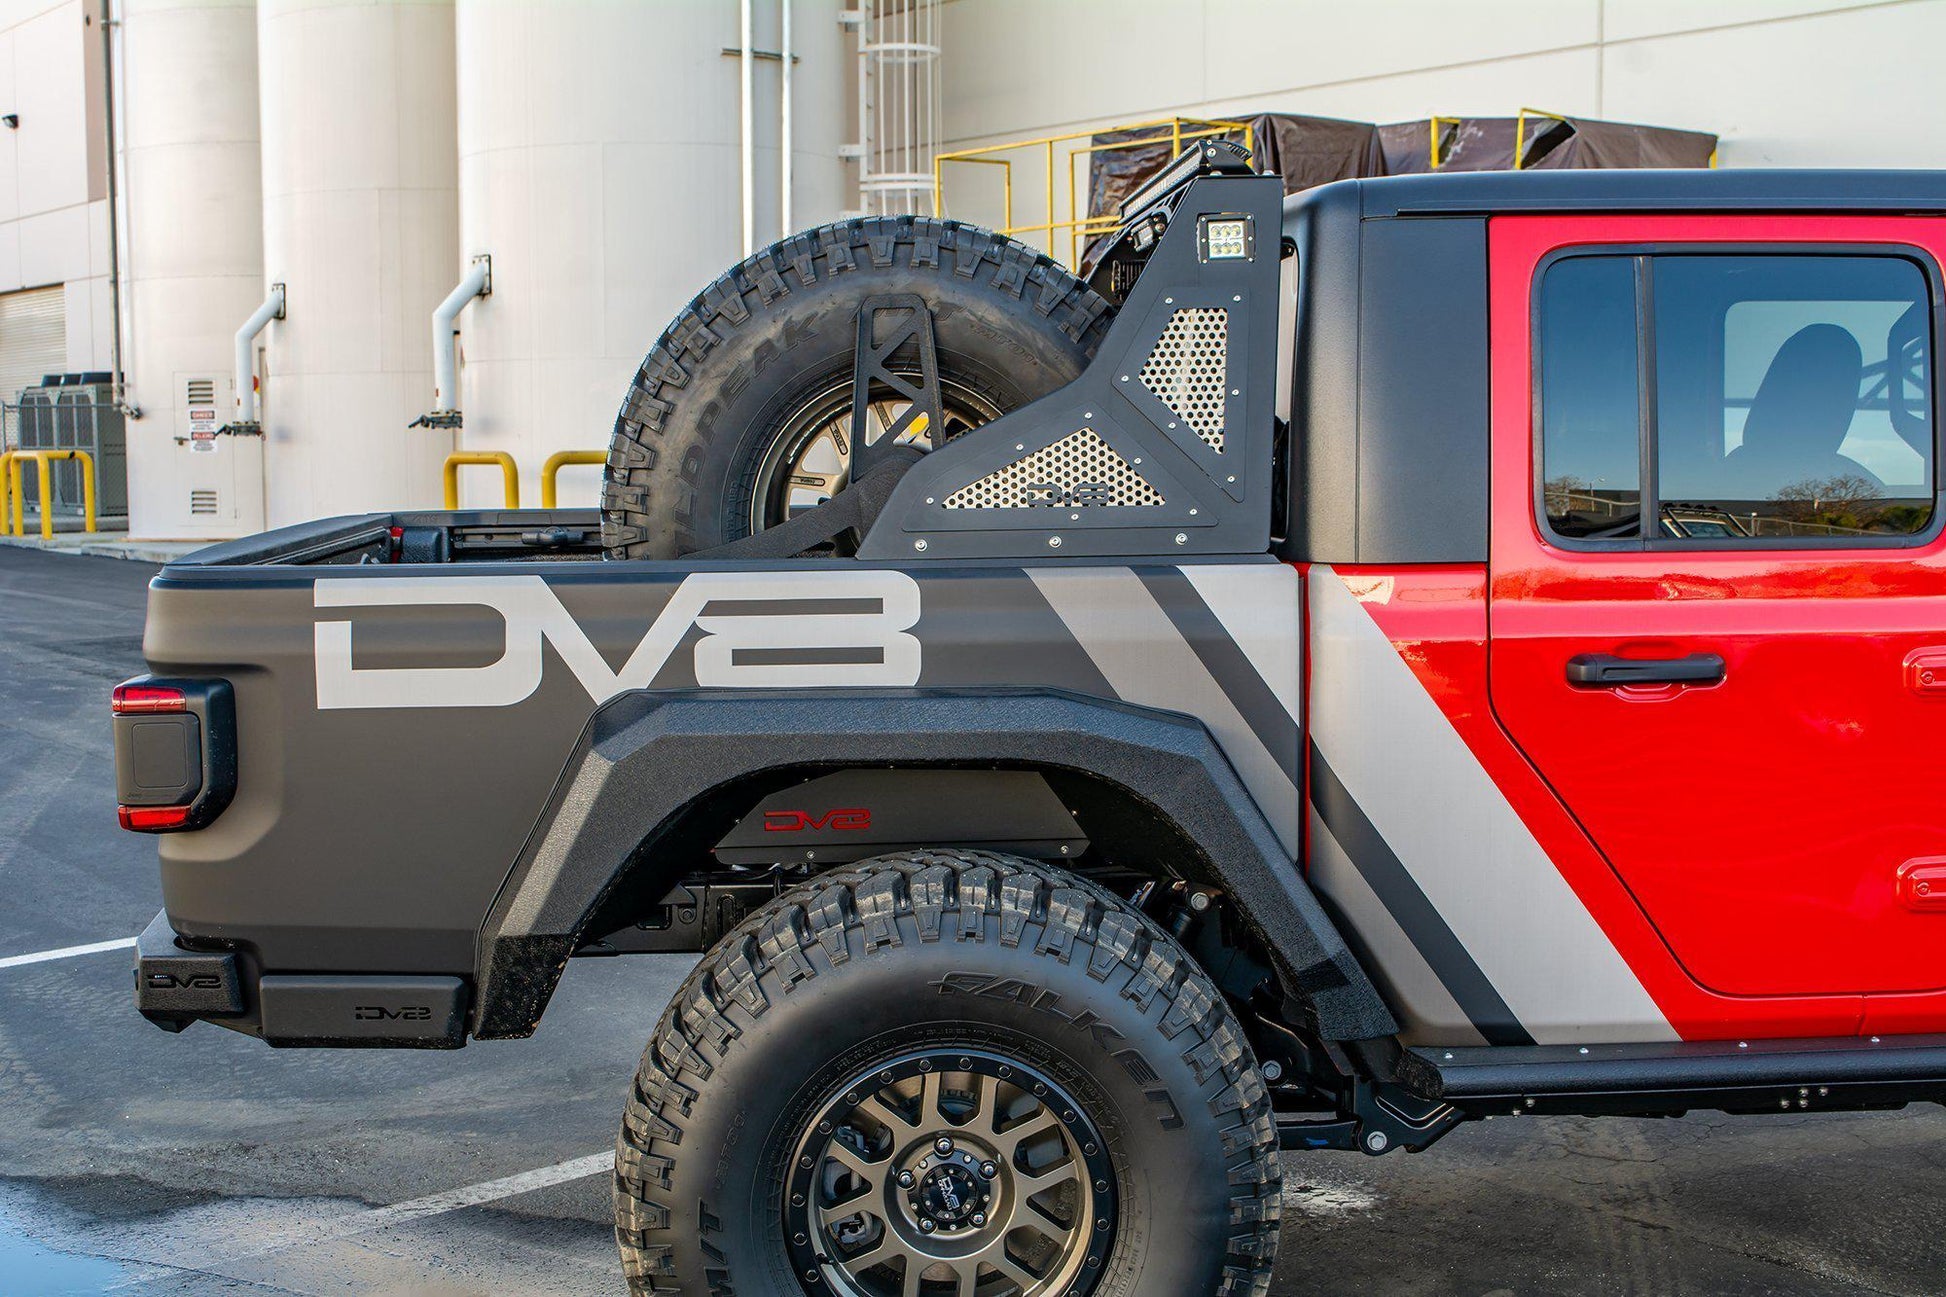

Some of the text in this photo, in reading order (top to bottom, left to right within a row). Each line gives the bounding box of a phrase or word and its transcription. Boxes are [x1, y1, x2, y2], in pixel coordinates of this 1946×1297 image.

[1027, 482, 1109, 506] DV8
[314, 570, 921, 709] DV8
[764, 808, 871, 831] DV8
[147, 974, 222, 989] DV8
[355, 1005, 432, 1020] DV8
